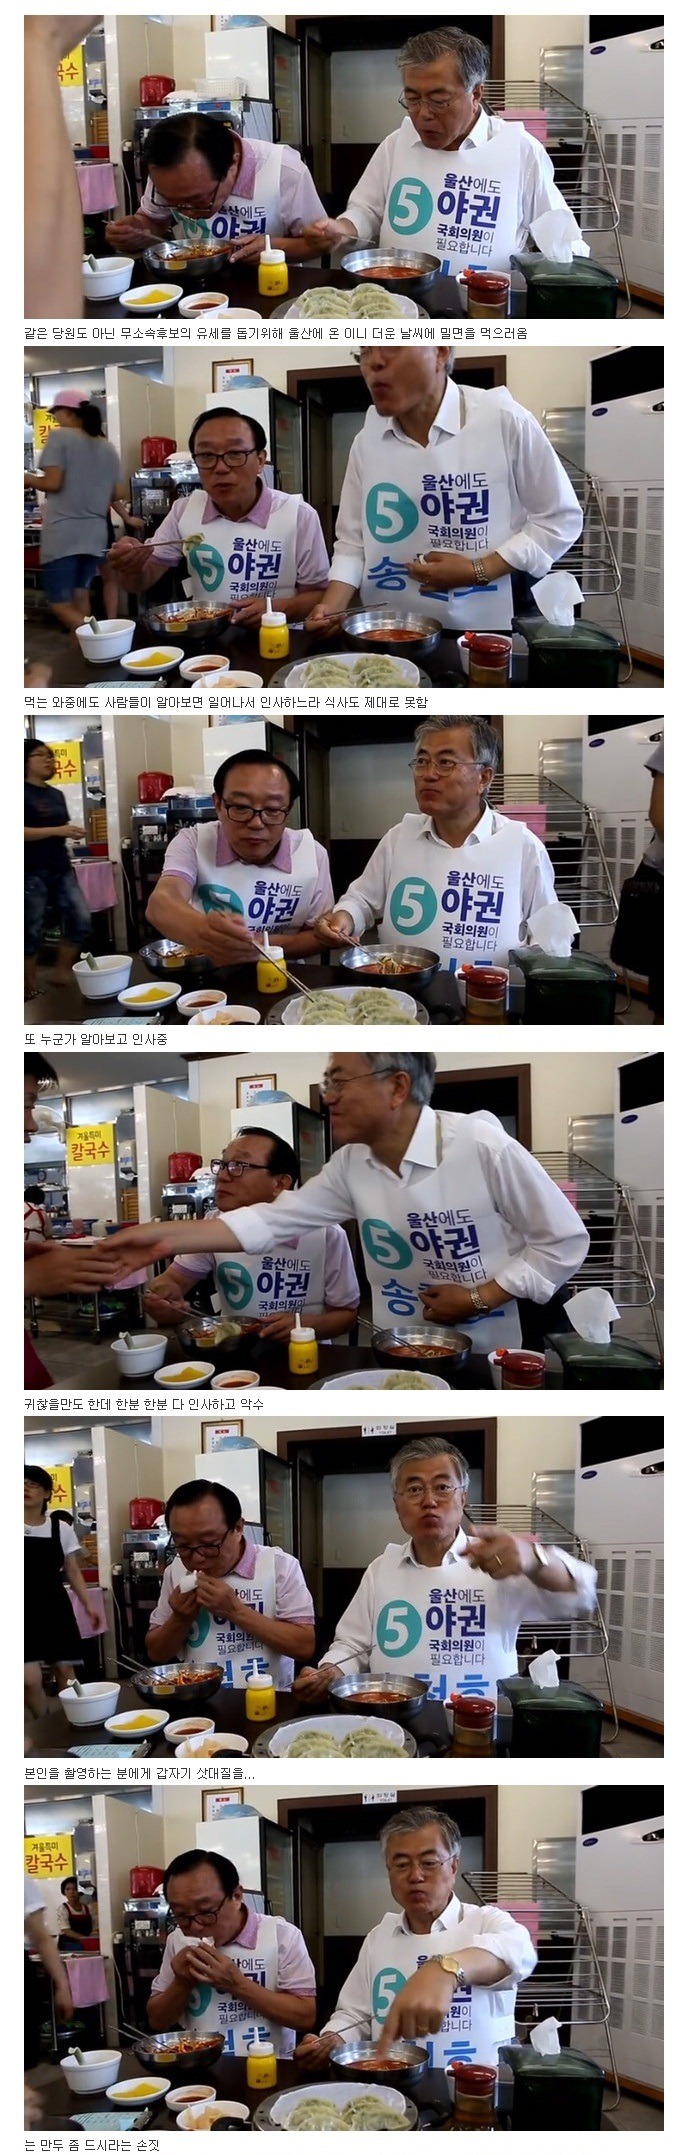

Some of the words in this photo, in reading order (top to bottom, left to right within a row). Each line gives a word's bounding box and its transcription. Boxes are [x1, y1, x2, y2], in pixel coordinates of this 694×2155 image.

[57, 62, 79, 82] 국수
[443, 172, 502, 195] 울산에도
[437, 190, 501, 229] 야권
[436, 223, 495, 244] 국회의원이
[435, 237, 493, 257] 필요합니다
[421, 472, 489, 492] 울산에도
[420, 489, 490, 525] 야권
[427, 524, 489, 540] 국회의원이
[232, 537, 283, 553] 울산에도
[429, 538, 490, 553] 필요합니다
[227, 552, 282, 581] 야권
[229, 581, 278, 593] 국회의원이
[52, 759, 77, 779] 국수
[254, 880, 303, 898] 울산에도
[446, 870, 505, 890] 울산에도
[247, 896, 300, 925] 야권
[441, 888, 504, 924] 야권
[442, 921, 499, 938] 국회의원이
[442, 936, 498, 952] 필요합니다
[71, 1140, 111, 1162] 칼국수
[406, 1209, 475, 1229] 울산에도
[409, 1224, 481, 1260] 야권
[261, 1256, 312, 1272] 울산에도
[422, 1255, 484, 1273] 국회의원이
[256, 1272, 311, 1300] 야권
[258, 1299, 306, 1311] 국회의원이
[235, 1589, 264, 1601] 에도
[429, 1588, 485, 1604] 울산에도
[425, 1604, 486, 1637] 야권
[429, 1639, 485, 1652] 국회의원이
[430, 1653, 485, 1666] 필요합니다
[25, 1852, 69, 1874] 칼국수
[440, 2020, 472, 2032] 합니다
